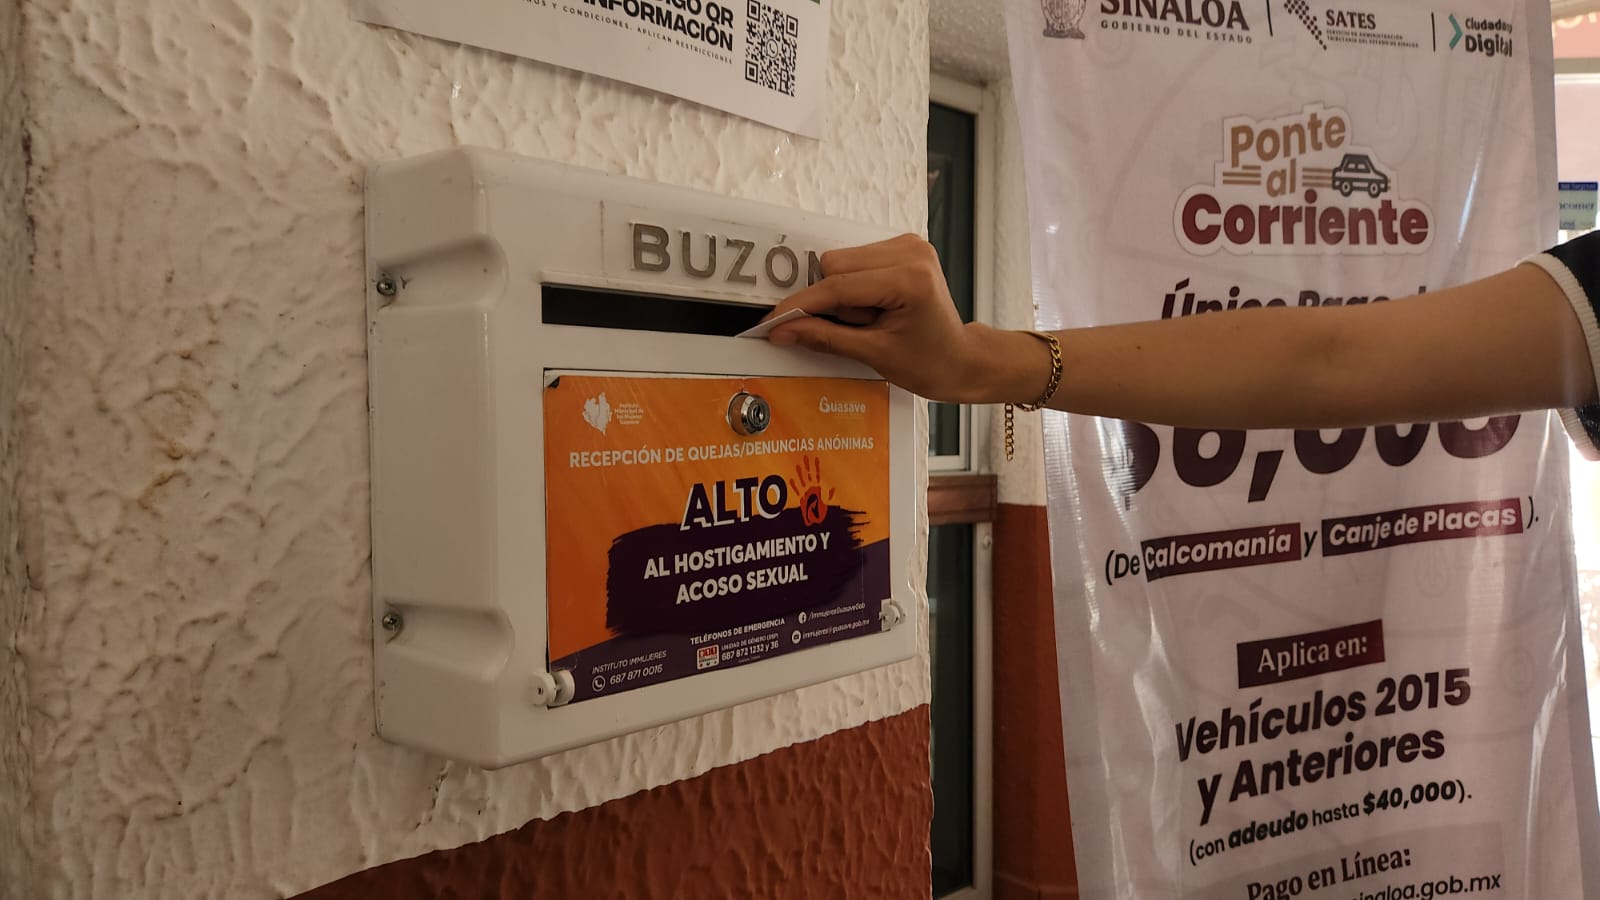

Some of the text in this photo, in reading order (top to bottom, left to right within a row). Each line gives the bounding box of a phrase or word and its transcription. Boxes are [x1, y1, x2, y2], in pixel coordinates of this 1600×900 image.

[705, 2, 734, 29] QR
[1100, 0, 1249, 31] SINALOA
[1100, 20, 1253, 45] GOBIERNO DEL ESTADO
[1325, 9, 1377, 30] SATES
[637, 27, 672, 43] APLICAN
[676, 40, 733, 65] RESTRICCIONES
[1465, 33, 1513, 57] Digital
[1231, 112, 1346, 168] Ponte
[1266, 159, 1297, 198] al
[1181, 189, 1429, 245] Corriente
[569, 434, 875, 468] RECEPCIÓN DE QUEJAS/DENUNCIAS ANÓNIMAS
[679, 474, 788, 531] ALTO
[643, 532, 831, 580] AL HOSTIGAMIENTO Y
[1105, 549, 1141, 585] (De
[1144, 528, 1292, 571] Calcomanía
[1303, 528, 1318, 557] y
[1328, 516, 1392, 549] Canje
[1393, 515, 1418, 537] de
[1423, 505, 1517, 533] Placas
[676, 563, 809, 604] ACOSO SEXUAL
[690, 618, 786, 646] TELÉFONOS DE EMERGENCIA
[591, 650, 667, 674] INSTITUTO IMMUJERES
[721, 650, 735, 662] 687
[764, 643, 770, 652] y
[1257, 635, 1368, 677] Aplica en:
[610, 664, 663, 685] 687 871 0016
[1175, 668, 1472, 762] Vehículos 2015
[1197, 729, 1446, 826] y Anteriores
[1189, 779, 1473, 866] (con adeudo hasta $40,000).
[1247, 848, 1412, 900] Pago en Línea:
